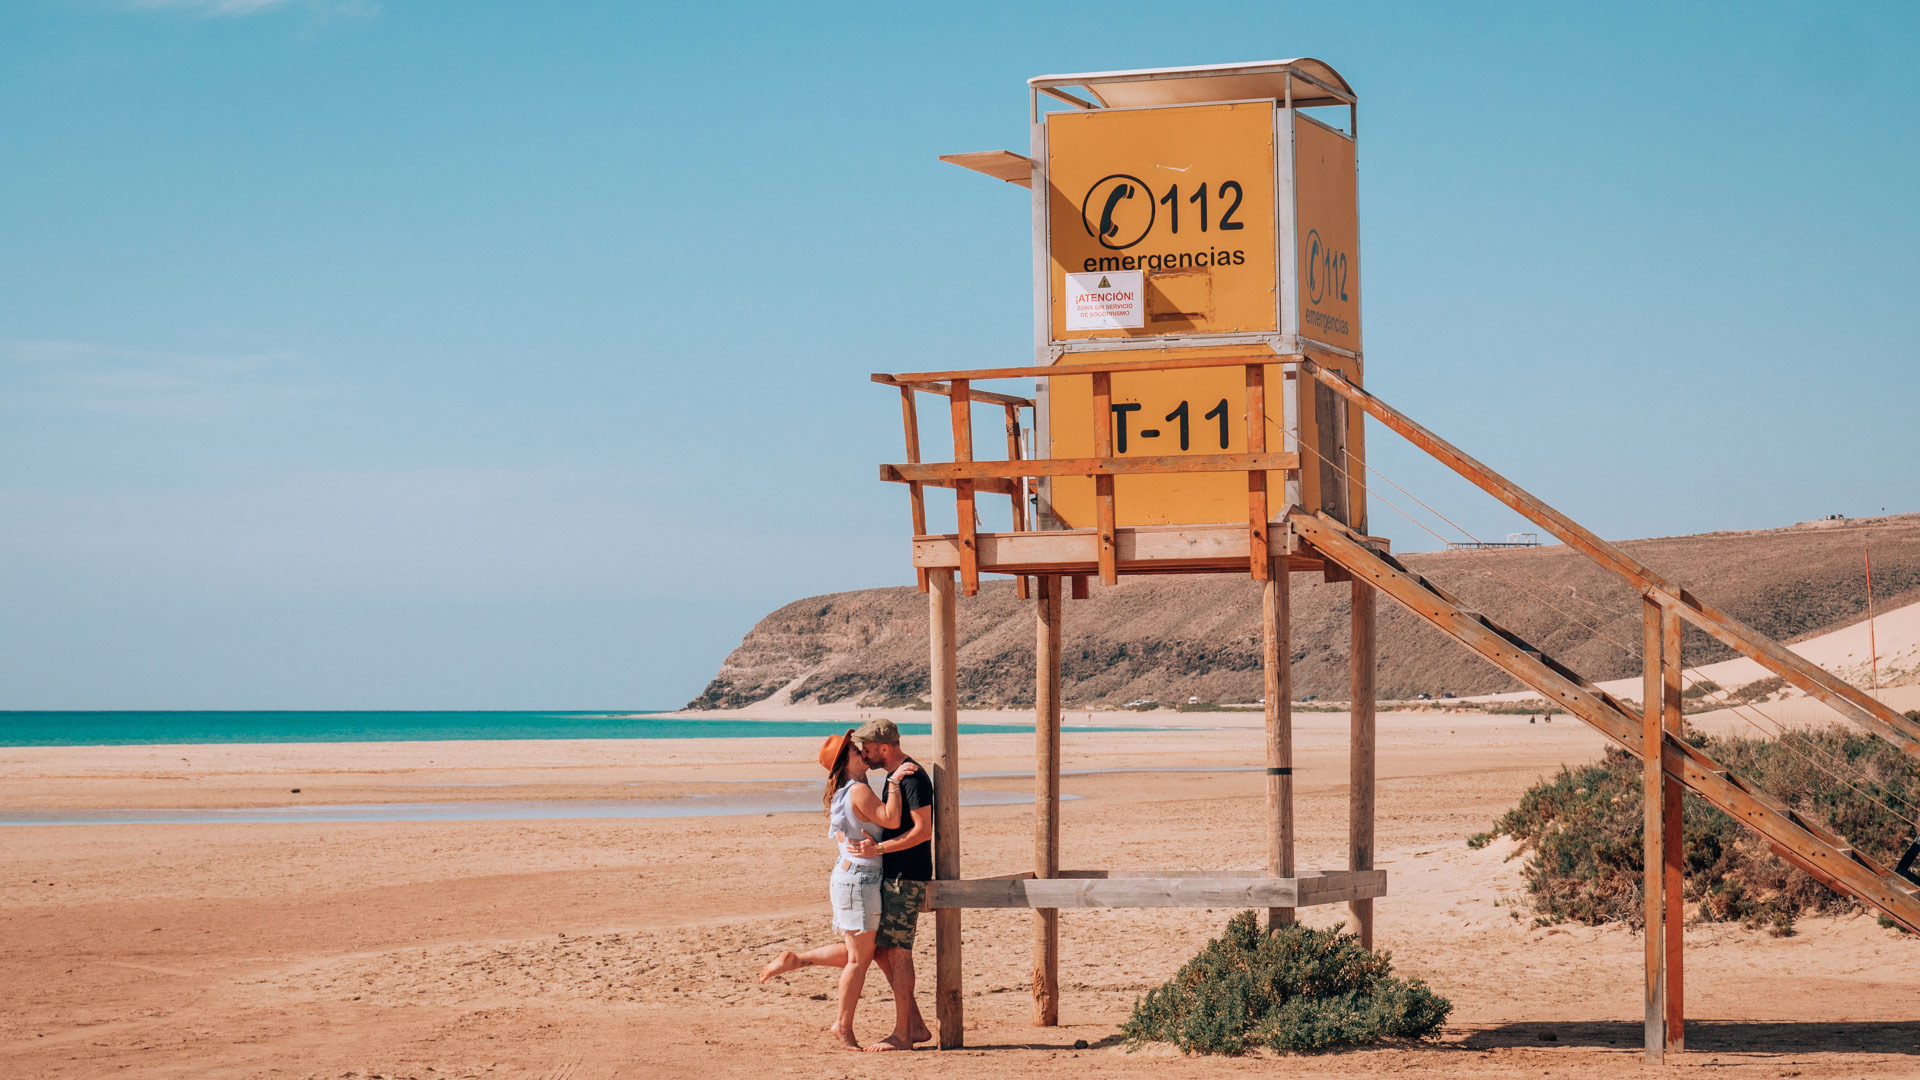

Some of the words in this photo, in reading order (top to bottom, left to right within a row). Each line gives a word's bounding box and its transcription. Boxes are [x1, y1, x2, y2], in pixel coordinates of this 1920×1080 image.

[1160, 180, 1244, 234] 112
[1083, 246, 1246, 273] emergencias
[1325, 247, 1348, 301] 112
[1075, 290, 1134, 304] ¡ATENCIÓN!
[1305, 308, 1349, 335] emergencias
[1111, 398, 1229, 453] T-11
